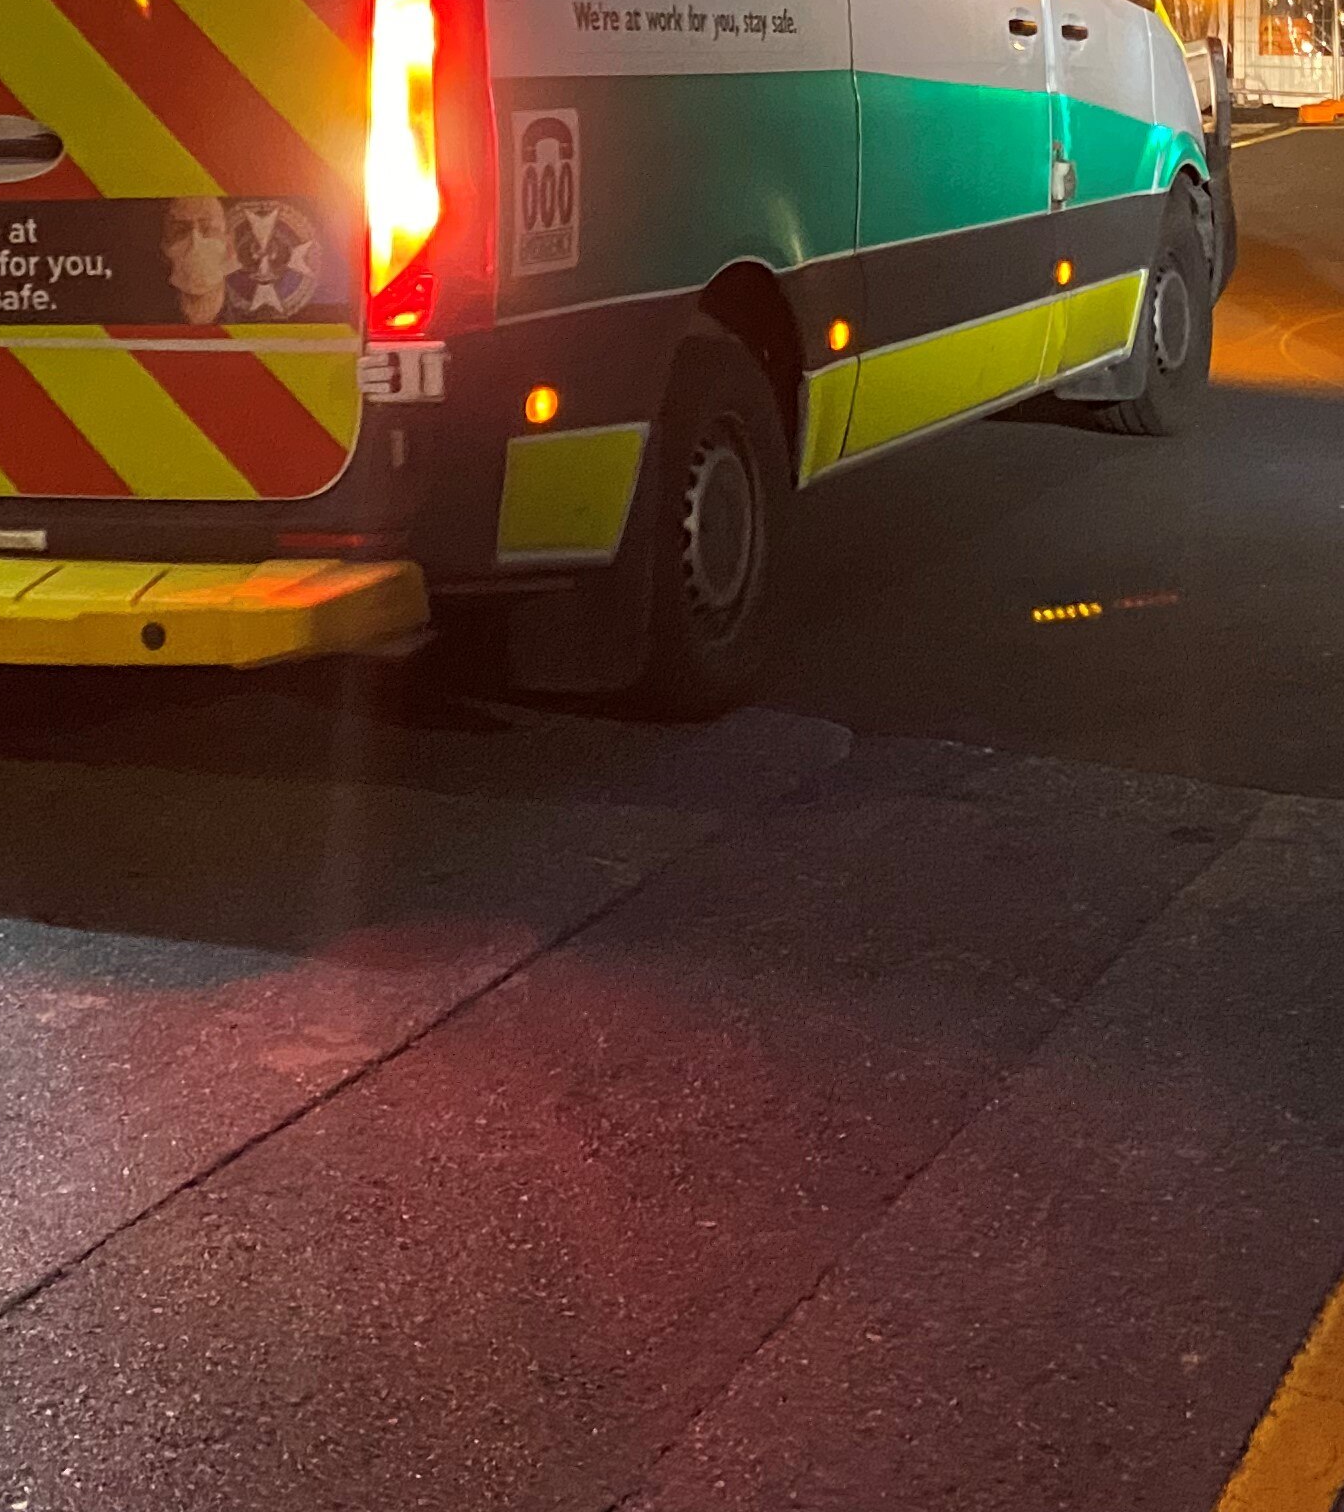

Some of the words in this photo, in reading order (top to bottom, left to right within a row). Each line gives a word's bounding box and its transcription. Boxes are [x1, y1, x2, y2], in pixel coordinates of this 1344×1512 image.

[573, 1, 619, 32] We're
[625, 7, 641, 32] at
[645, 4, 683, 33] work
[688, 4, 707, 33] for
[713, 10, 739, 41] you,
[744, 12, 767, 41] stay
[772, 8, 798, 35] safe.
[521, 162, 573, 231] 000
[9, 218, 38, 244] at
[47, 255, 113, 284] you,
